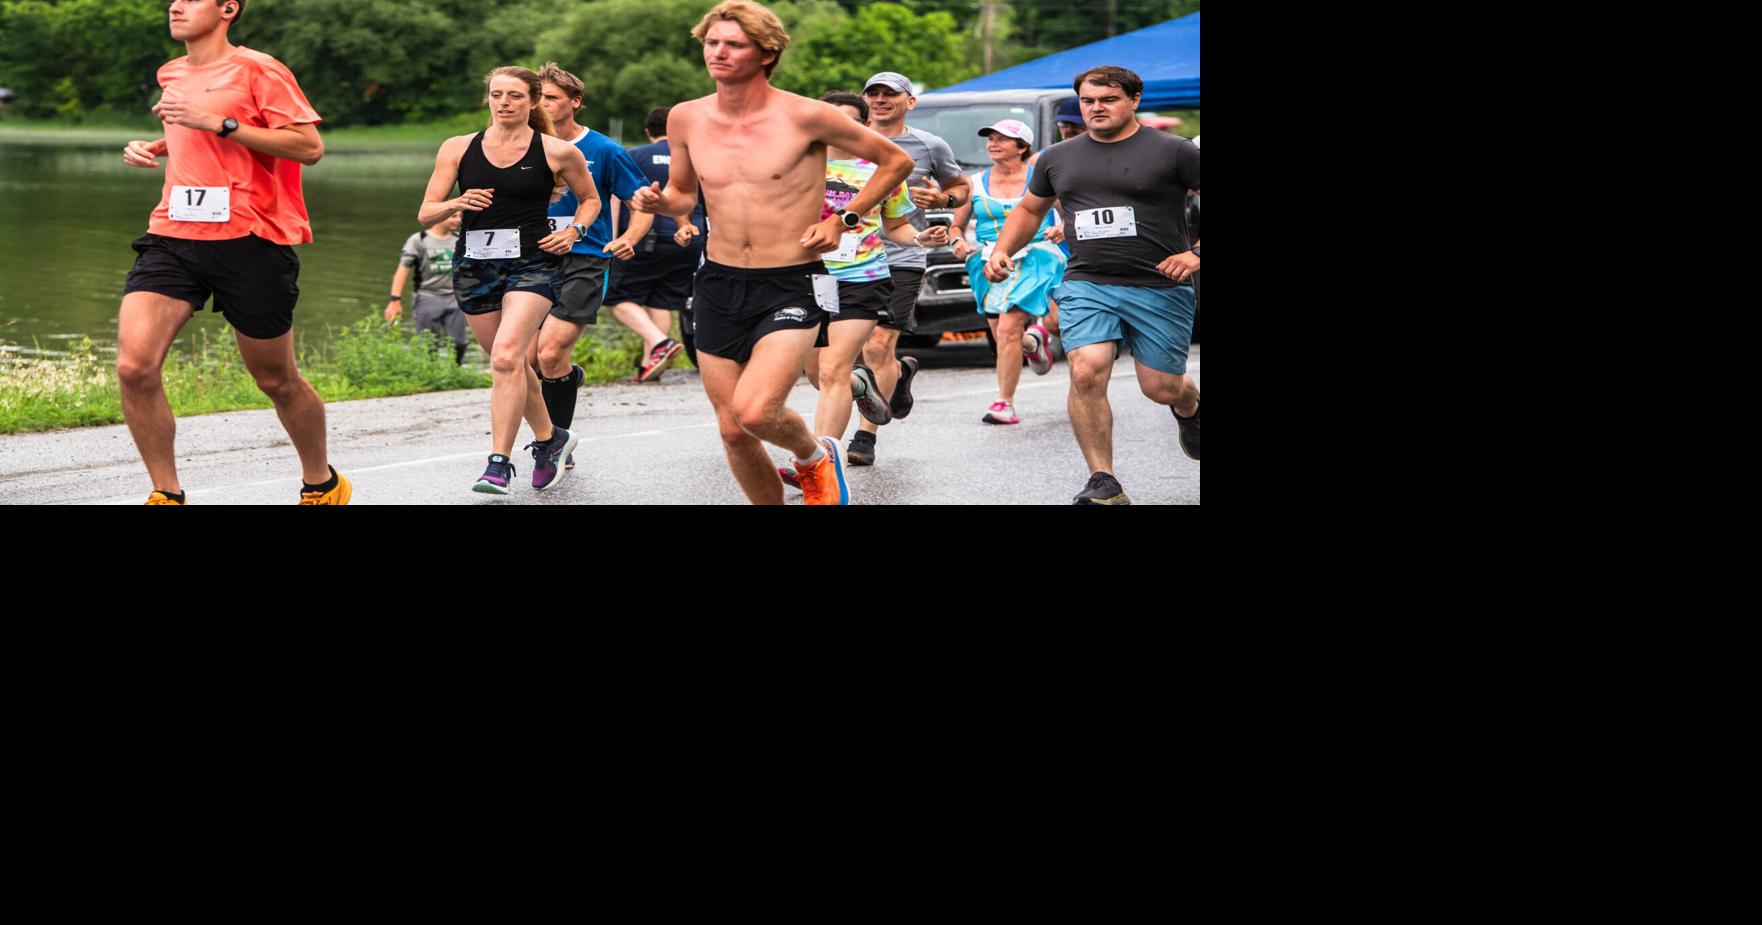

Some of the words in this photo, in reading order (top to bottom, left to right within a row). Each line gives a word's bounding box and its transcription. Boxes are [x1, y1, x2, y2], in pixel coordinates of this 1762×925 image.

[185, 188, 207, 206] 17
[1091, 209, 1114, 226] 10
[484, 231, 495, 247] 7
